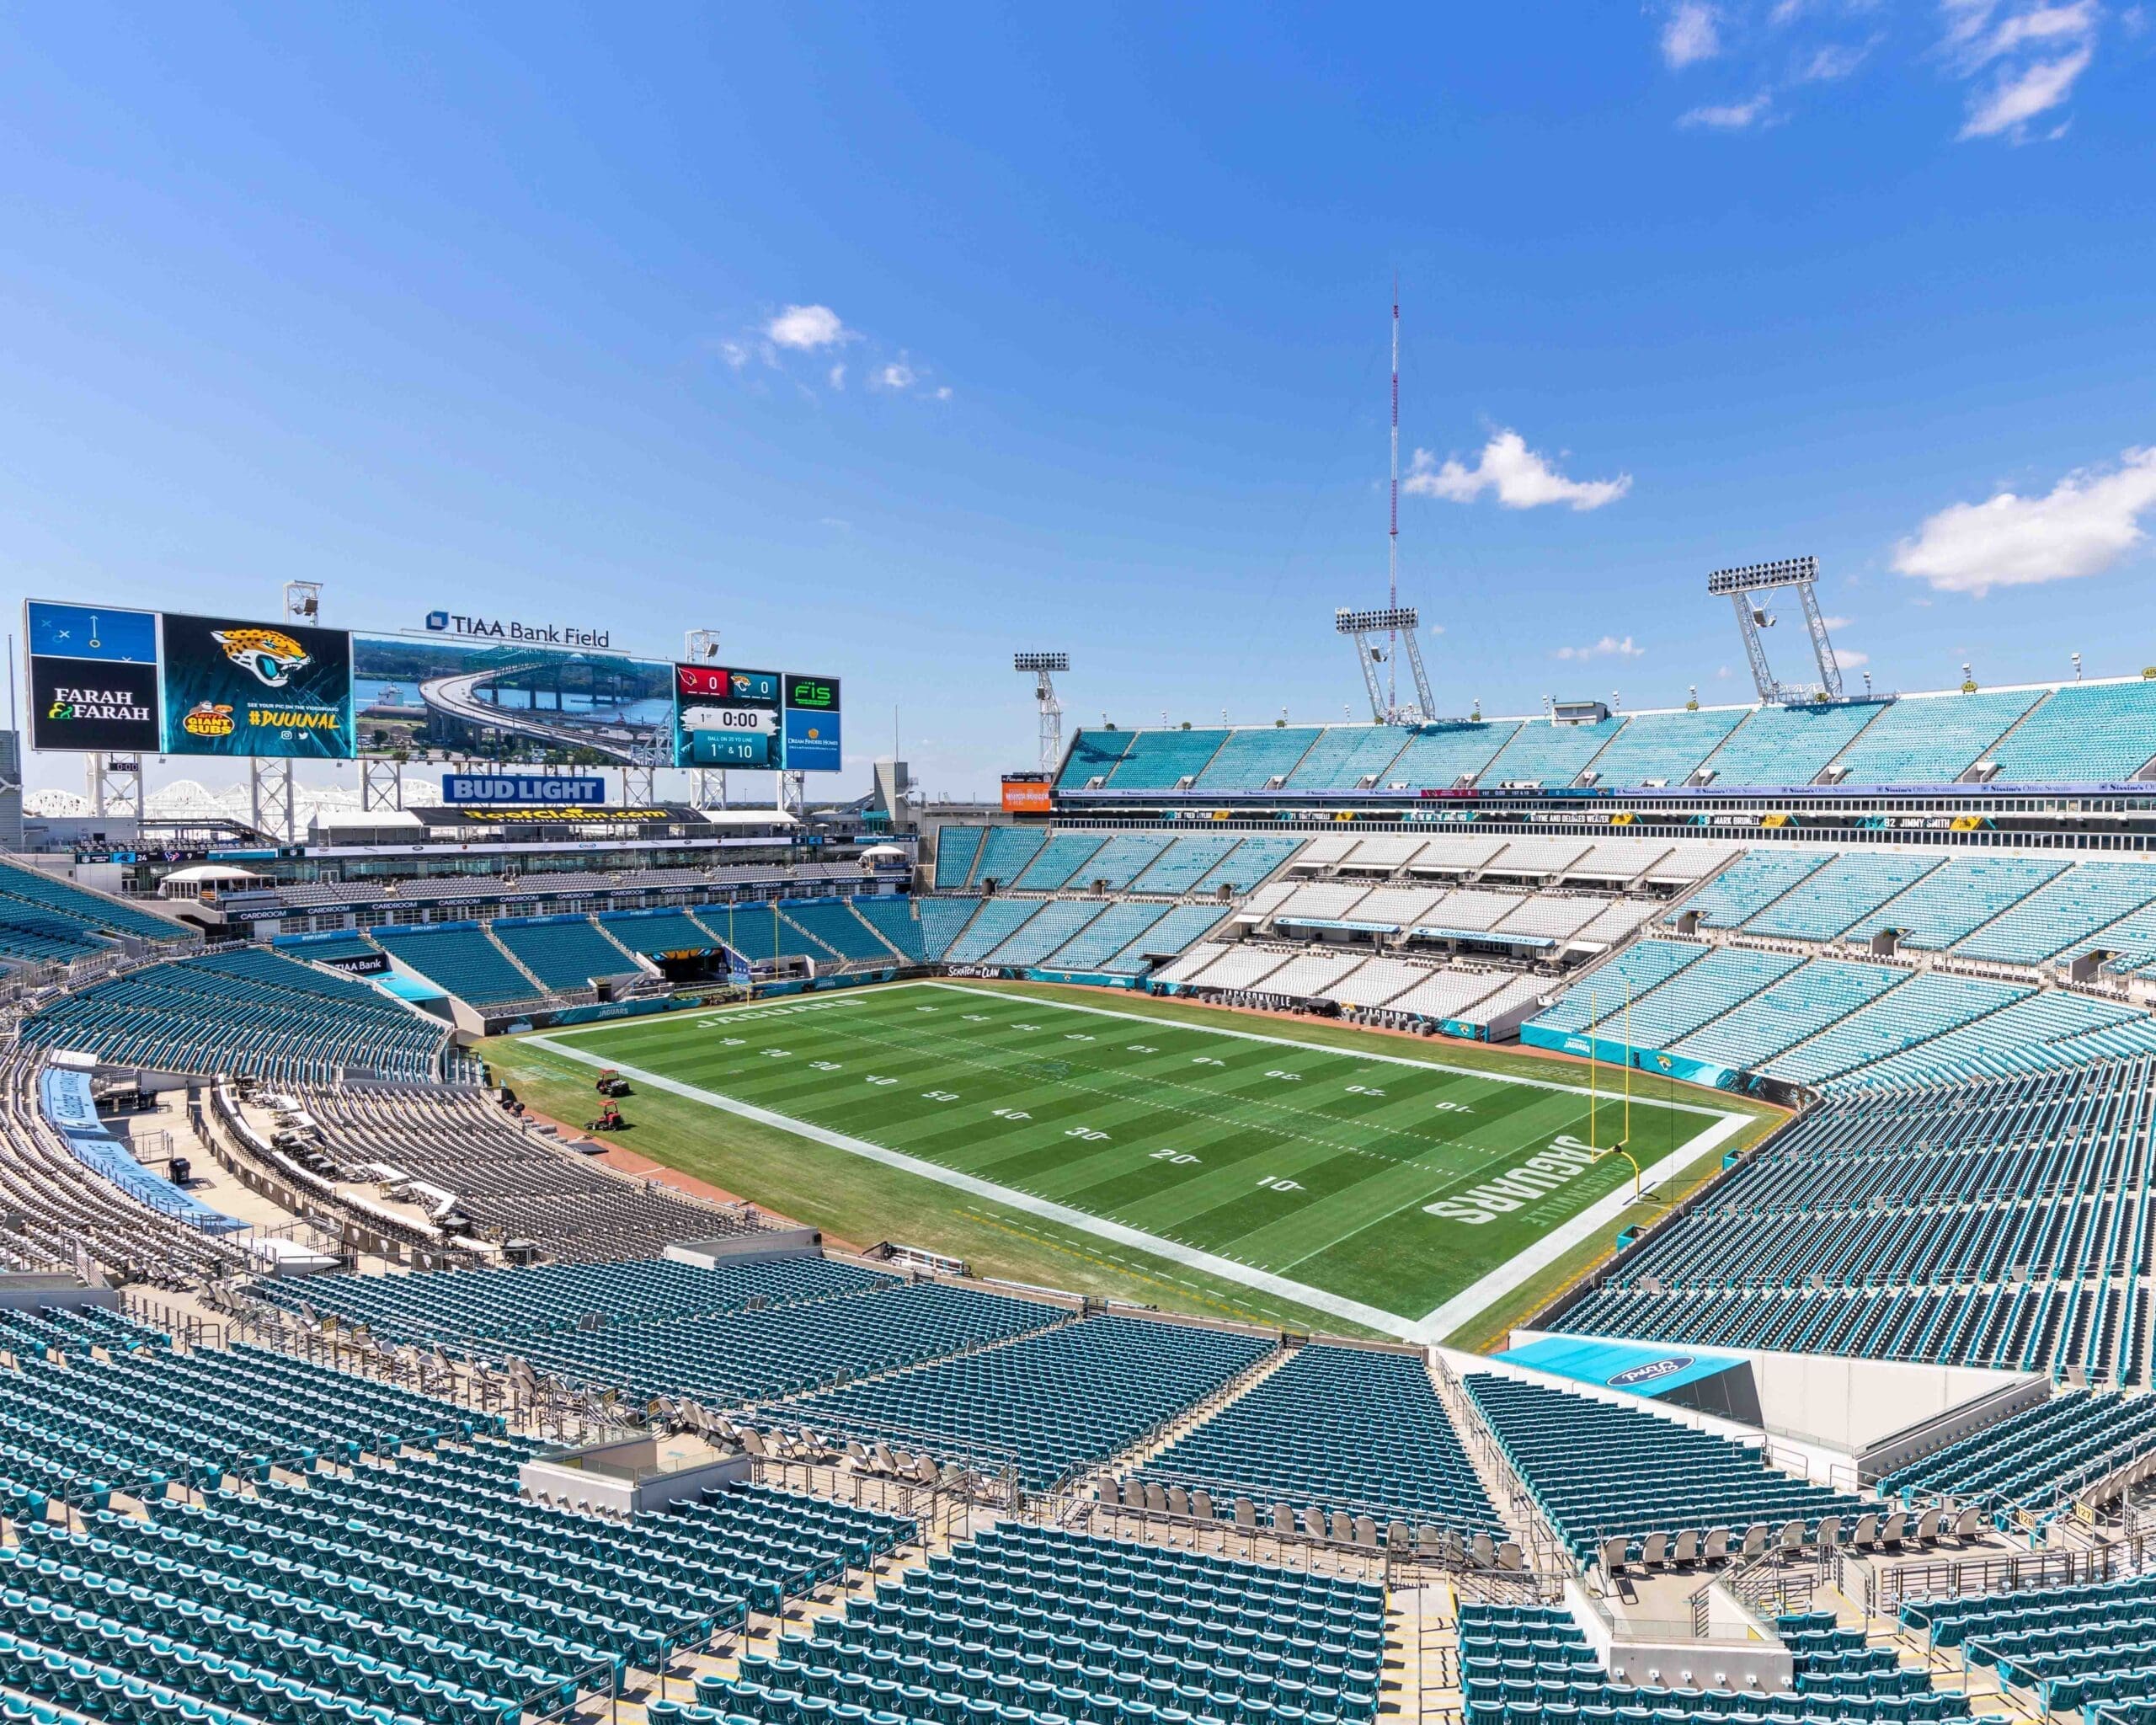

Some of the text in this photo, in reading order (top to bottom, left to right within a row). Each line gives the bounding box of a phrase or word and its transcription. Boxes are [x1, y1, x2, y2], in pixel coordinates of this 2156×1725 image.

[451, 615, 609, 648] TIAA Bank Field
[708, 676, 718, 690] 0
[760, 681, 769, 694] 0
[54, 688, 134, 706] FARAH
[795, 685, 831, 700] FIS
[47, 702, 151, 721] & FARAH
[188, 717, 230, 727] GIANT
[248, 710, 341, 730] #DUUUVAL
[723, 711, 758, 728] 0:00
[186, 725, 232, 734] SUBS
[710, 744, 753, 758] 1ST & 10
[453, 779, 597, 799] BUD LIGHT
[2109, 783, 2143, 792] Sissine's
[464, 807, 668, 821] RoofClaim.com
[1549, 814, 1561, 822] AND
[1714, 816, 1732, 825] MARK
[1733, 816, 1760, 825] BRUNELL
[1884, 818, 1951, 829] 82 JIMMY SMITH
[371, 901, 418, 910] CARDROOM
[438, 898, 481, 907] CARDROOM
[240, 910, 287, 921] CARDROOM
[307, 905, 350, 915] CARDROOM
[1299, 918, 1344, 930] Gallagher
[1440, 929, 1540, 945] Gallagher INSURANCE
[359, 959, 382, 970] Bank
[947, 965, 975, 978] SCRATCH
[982, 966, 1000, 979] CLAW
[597, 1007, 628, 1018] JAGUARS
[697, 999, 867, 1029] JAGUARS
[760, 1049, 792, 1057] 20
[1564, 1040, 1591, 1053] JAGUARS
[808, 1060, 842, 1071] 30
[865, 1075, 899, 1086] 40
[1264, 1070, 1302, 1081] 30
[921, 1091, 959, 1102] 50
[1345, 1085, 1386, 1097] 20
[991, 1108, 1033, 1119] 40
[1435, 1102, 1476, 1114] 10
[1065, 1127, 1112, 1140] 30
[1149, 1149, 1203, 1164] 20
[1256, 1175, 1307, 1192] 10
[1422, 1135, 1609, 1225] JAGUARS
[1519, 1157, 1632, 1228] JACKSONVILLE
[1620, 1361, 1679, 1382] Ford
[2077, 1505, 2091, 1519] 127
[2020, 1513, 2034, 1527] 128
